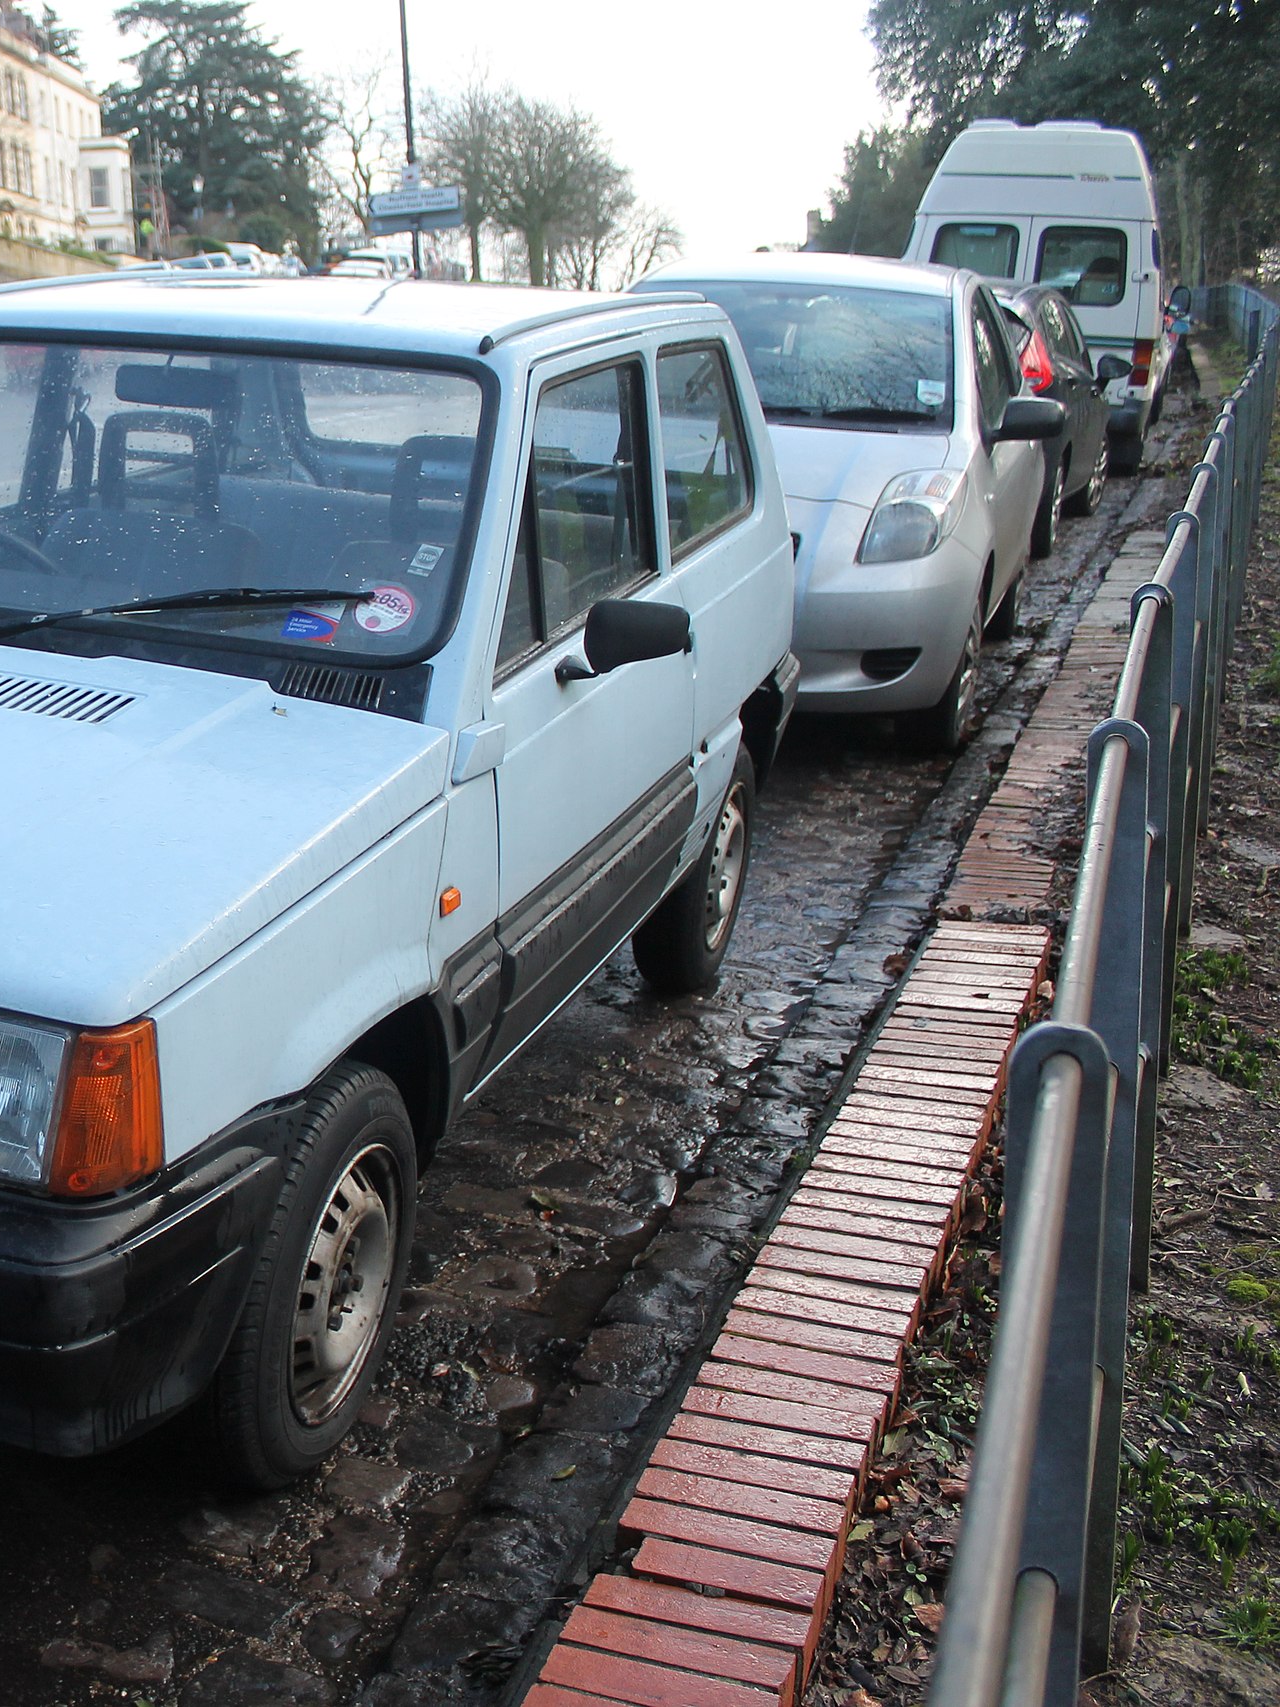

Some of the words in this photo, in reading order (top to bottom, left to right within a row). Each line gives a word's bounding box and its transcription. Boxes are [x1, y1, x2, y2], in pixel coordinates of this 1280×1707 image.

[418, 552, 437, 561] STOP
[379, 594, 401, 608] 05
[289, 622, 319, 631] Emergency
